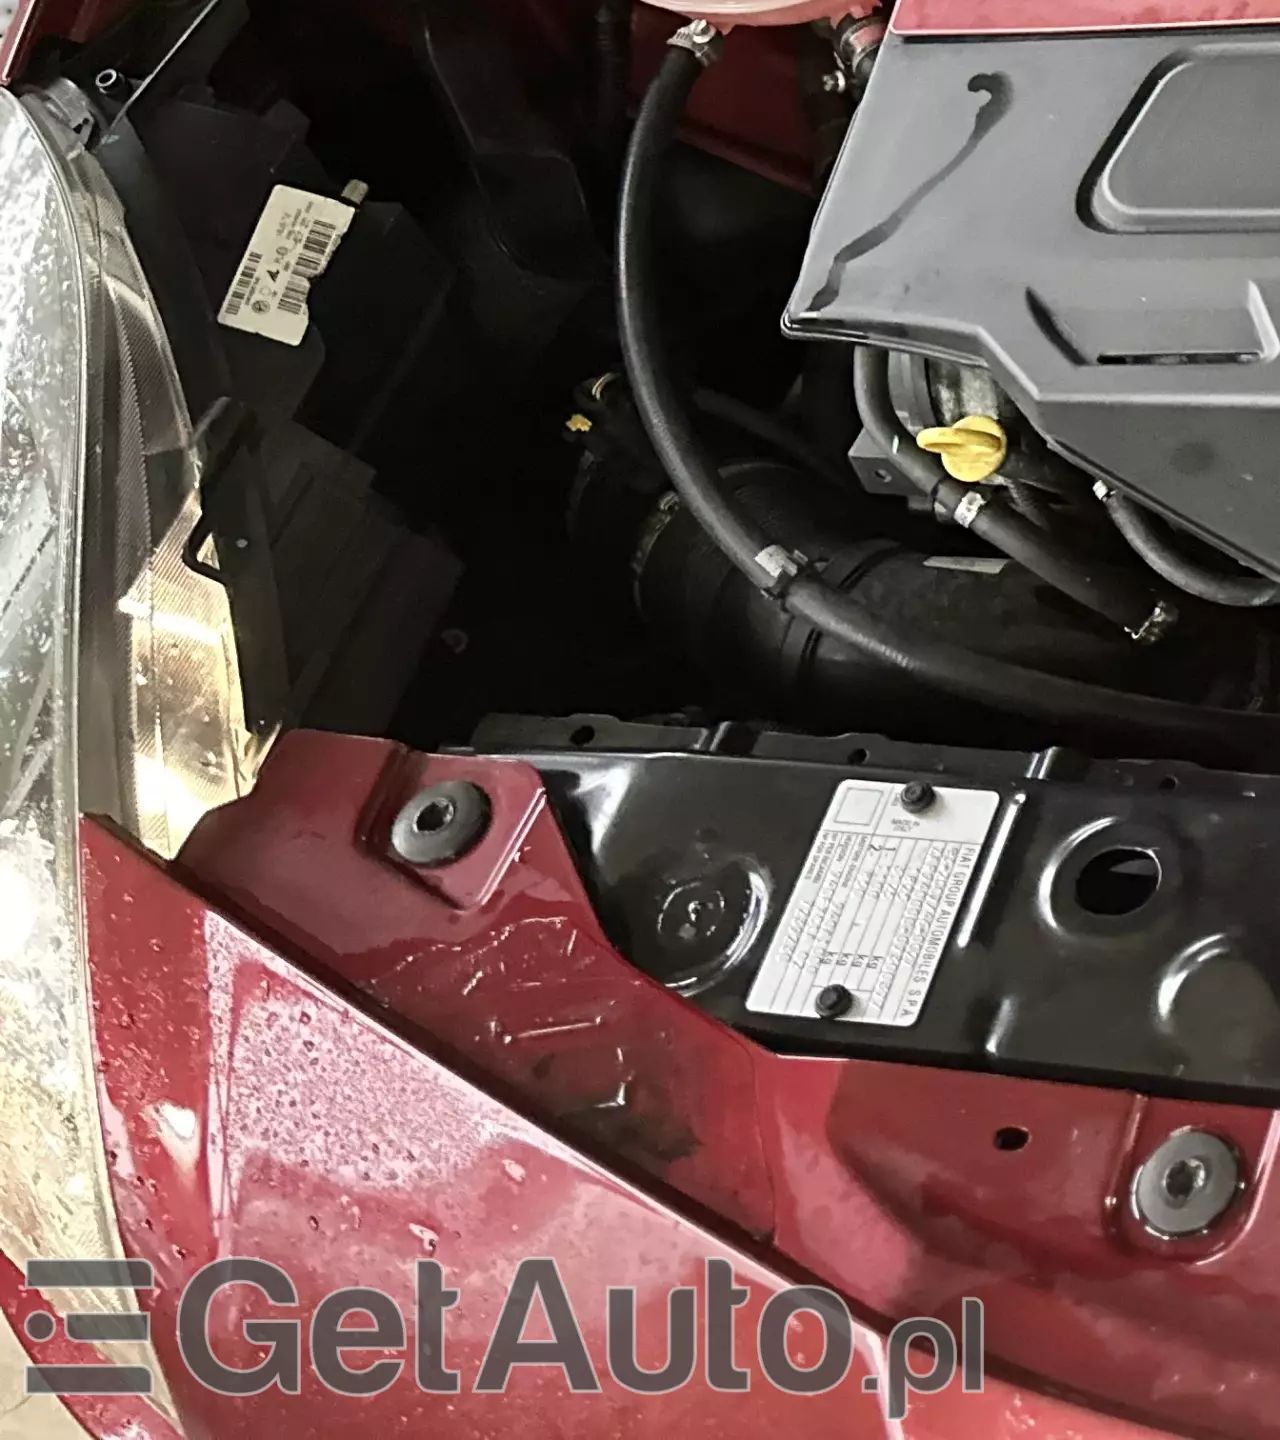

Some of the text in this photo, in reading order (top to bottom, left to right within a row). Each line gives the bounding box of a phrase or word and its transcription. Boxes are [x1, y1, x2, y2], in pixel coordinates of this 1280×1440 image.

[955, 847, 975, 869] FIAT
[941, 871, 966, 906] GROUP
[912, 909, 952, 983] AUTOMOBILES
[820, 949, 837, 965] kg
[835, 951, 853, 966] kg
[850, 953, 868, 968] kg
[866, 955, 884, 970] kg
